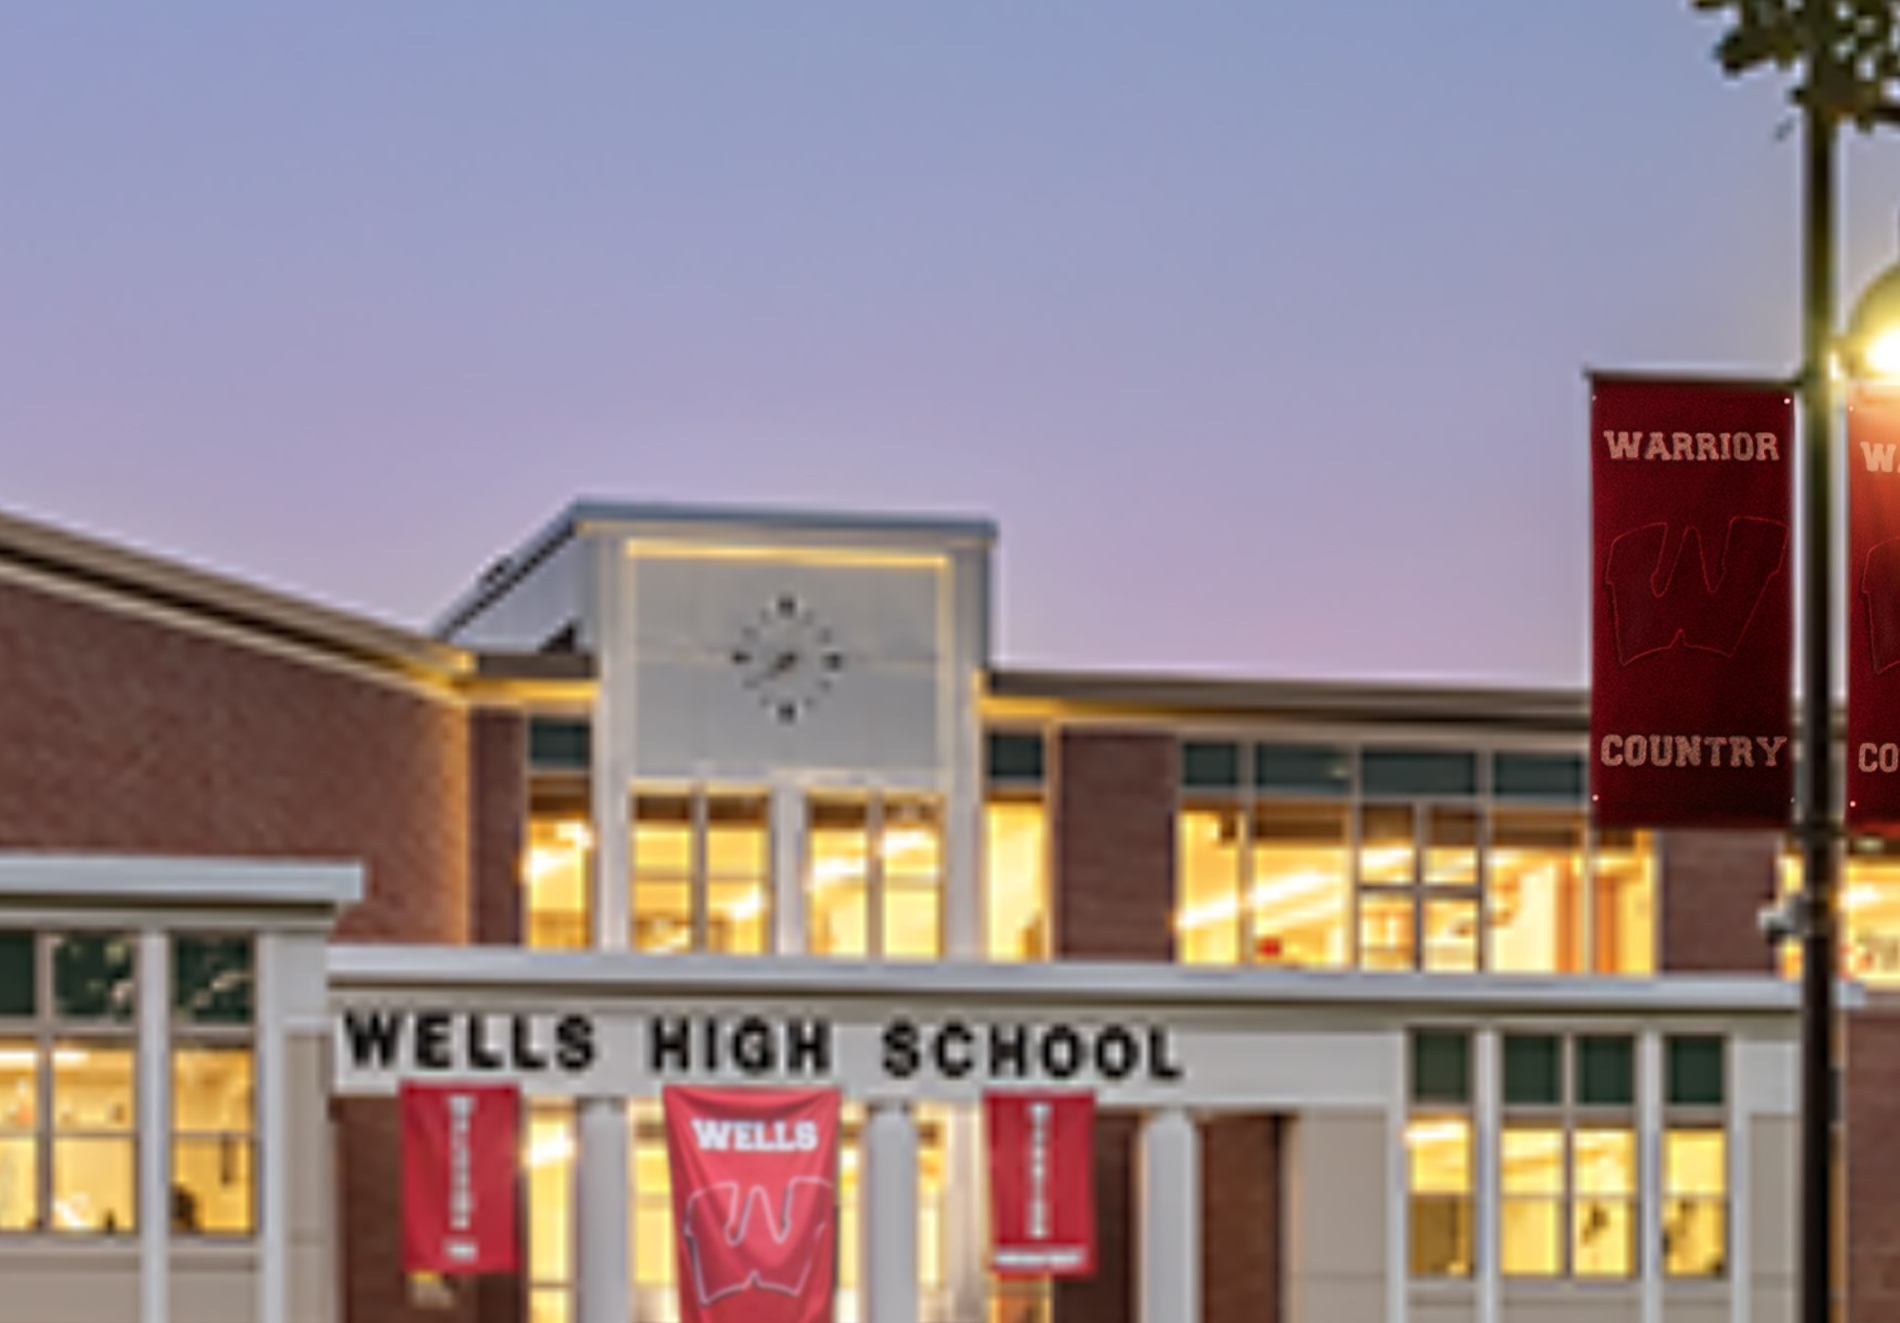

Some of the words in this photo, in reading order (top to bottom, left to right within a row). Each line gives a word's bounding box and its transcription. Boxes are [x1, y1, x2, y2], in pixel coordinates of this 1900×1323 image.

[1603, 430, 1780, 461] WARRIOR
[1600, 734, 1788, 767] COUNTRY
[344, 1010, 597, 1072] WELLS
[650, 1015, 833, 1074] HIGH
[880, 1022, 1185, 1080] SCHOOL
[691, 1118, 819, 1151] WELLS
